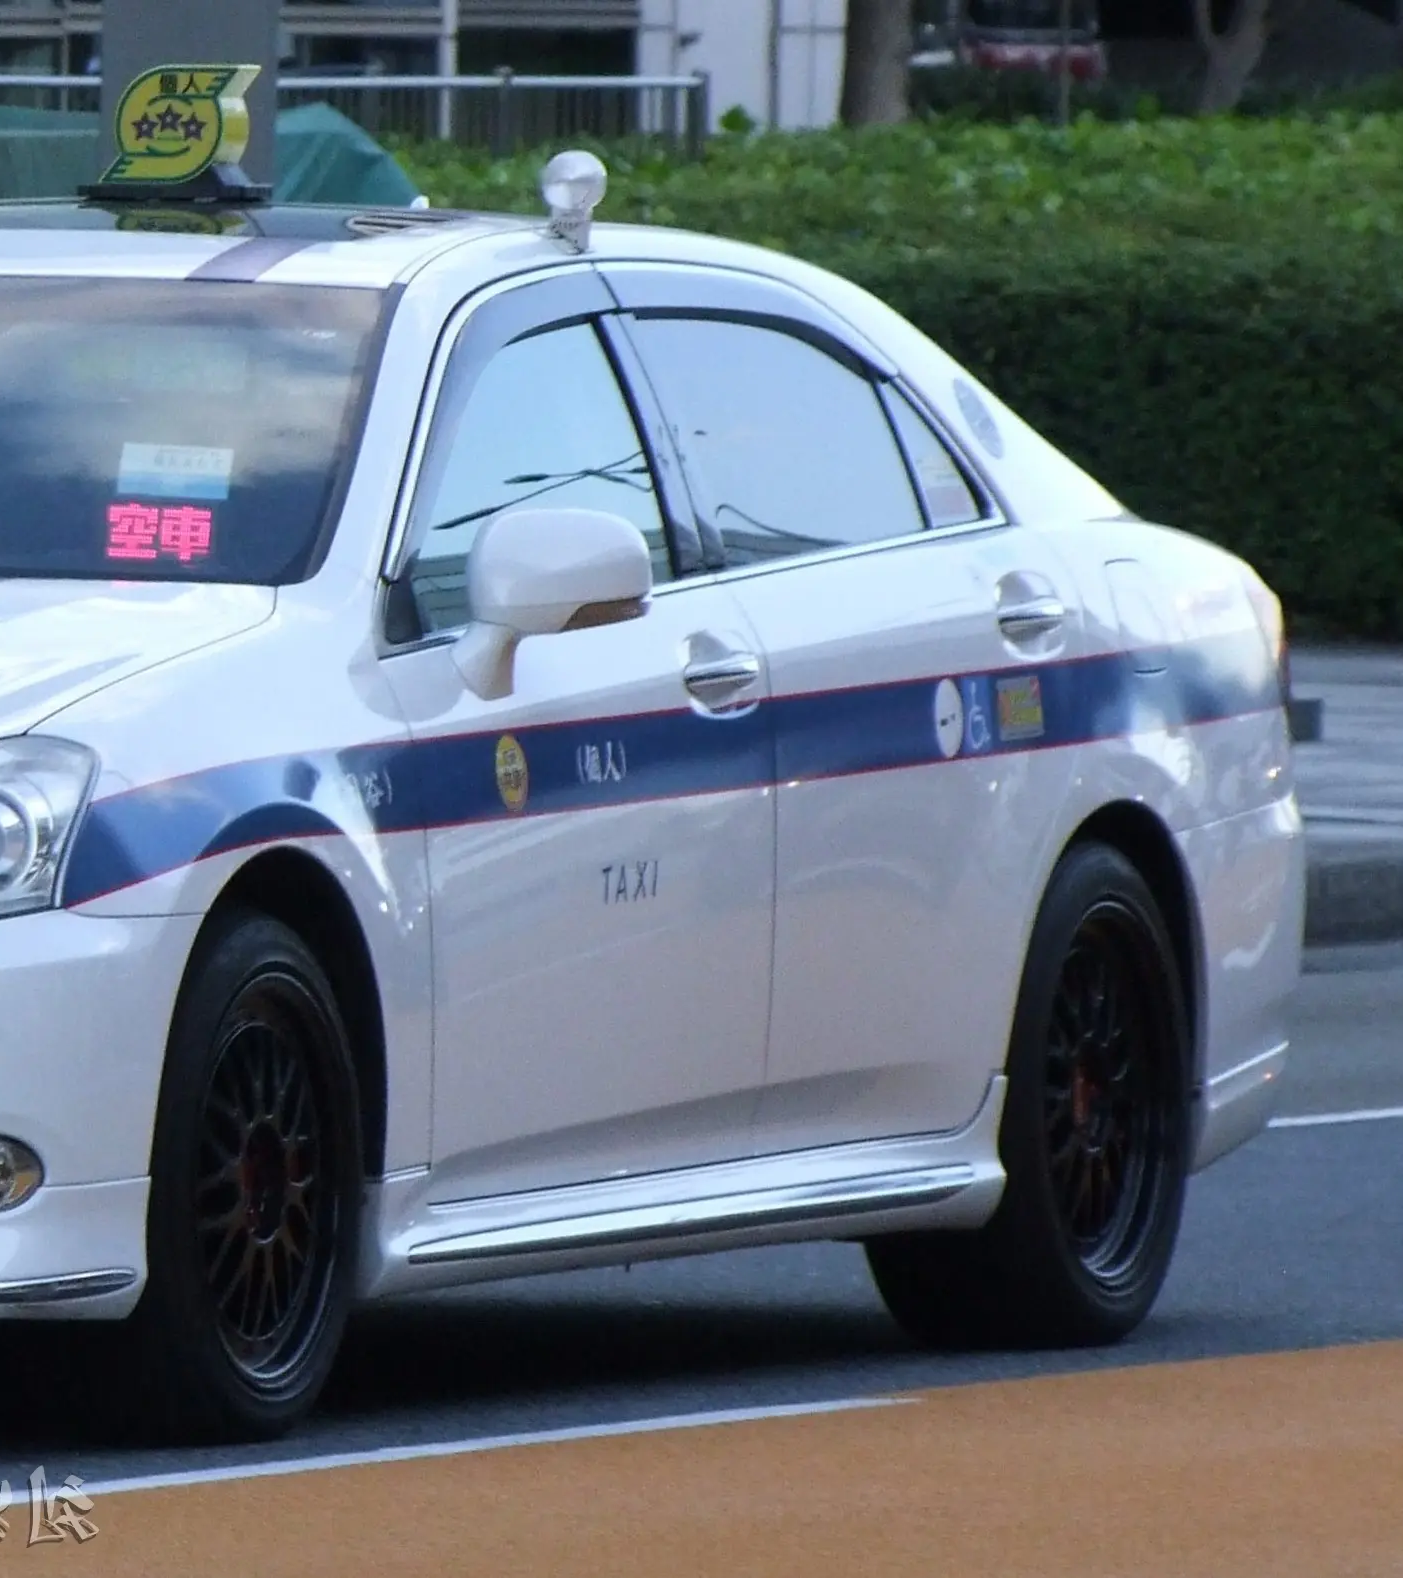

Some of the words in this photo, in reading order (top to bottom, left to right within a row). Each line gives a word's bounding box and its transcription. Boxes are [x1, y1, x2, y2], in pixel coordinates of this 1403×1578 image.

[159, 72, 202, 94] 個人
[107, 502, 212, 561] 空車
[602, 859, 659, 905] TAXI
